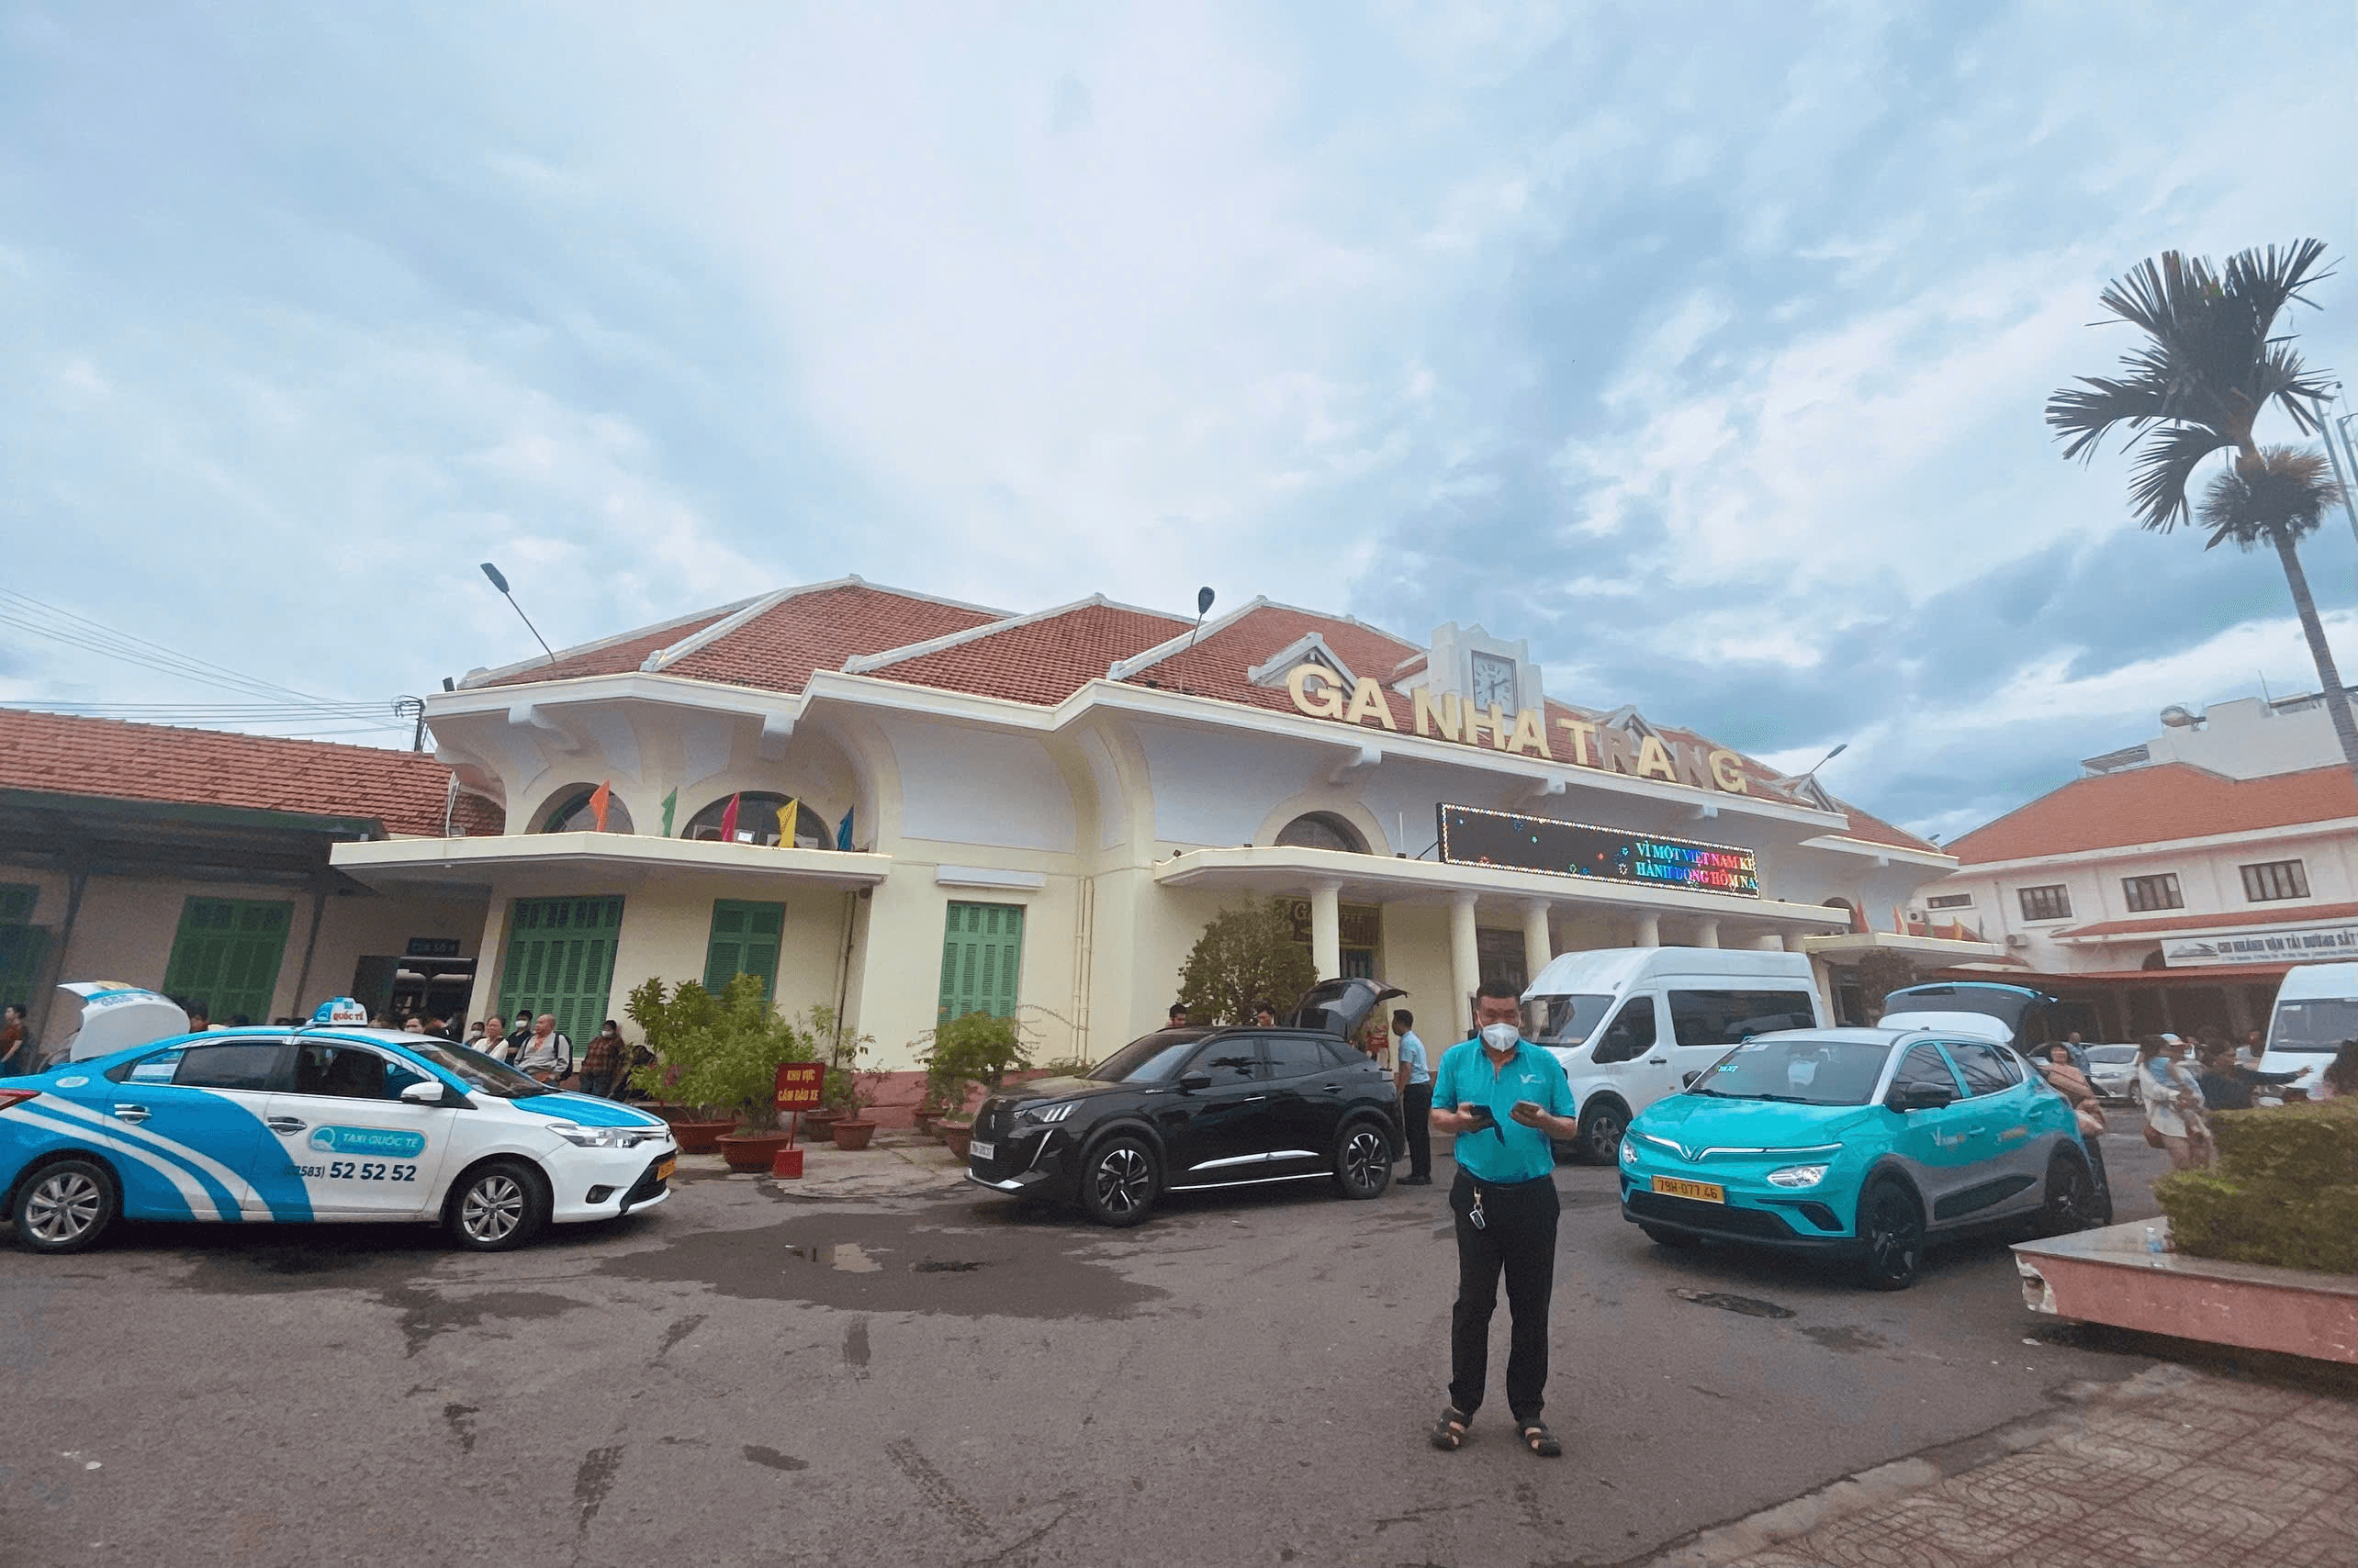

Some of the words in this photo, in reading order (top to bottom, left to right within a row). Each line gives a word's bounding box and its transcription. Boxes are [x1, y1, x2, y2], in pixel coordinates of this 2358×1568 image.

[1286, 663, 1397, 730] GA
[1410, 687, 1552, 758] NHA
[1556, 718, 1747, 793] TRANG
[1636, 840, 1651, 857] VÌ
[1653, 845, 1680, 863] MỘT
[1682, 849, 1709, 868] VIỆT
[1710, 853, 1739, 868] NAM
[1636, 859, 1672, 879] HÀNH
[333, 1011, 354, 1022] QUỐC
[355, 1011, 364, 1021] TẾ
[810, 1089, 819, 1101] XE
[342, 1133, 366, 1144] TAXI
[369, 1135, 403, 1147] QUỐC
[406, 1137, 420, 1148] TẾ
[330, 1161, 355, 1179] 52
[360, 1163, 386, 1181] 52
[391, 1164, 417, 1182] 52
